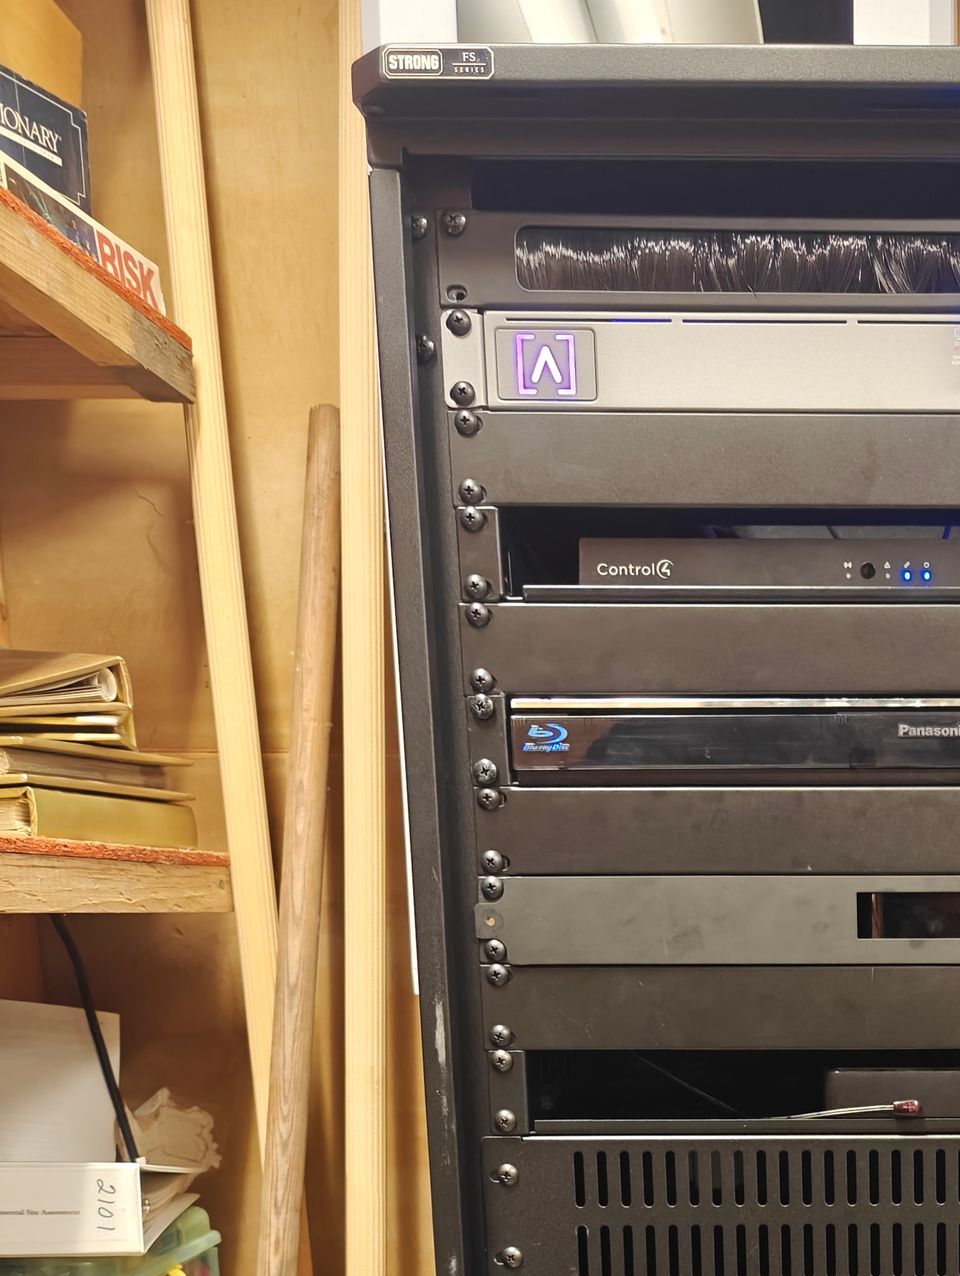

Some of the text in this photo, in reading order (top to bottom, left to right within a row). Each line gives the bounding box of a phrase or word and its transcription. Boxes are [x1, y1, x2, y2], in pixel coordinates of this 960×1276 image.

[388, 54, 440, 70] STRONG
[96, 229, 160, 311] RISK
[96, 1178, 117, 1231] 2101
